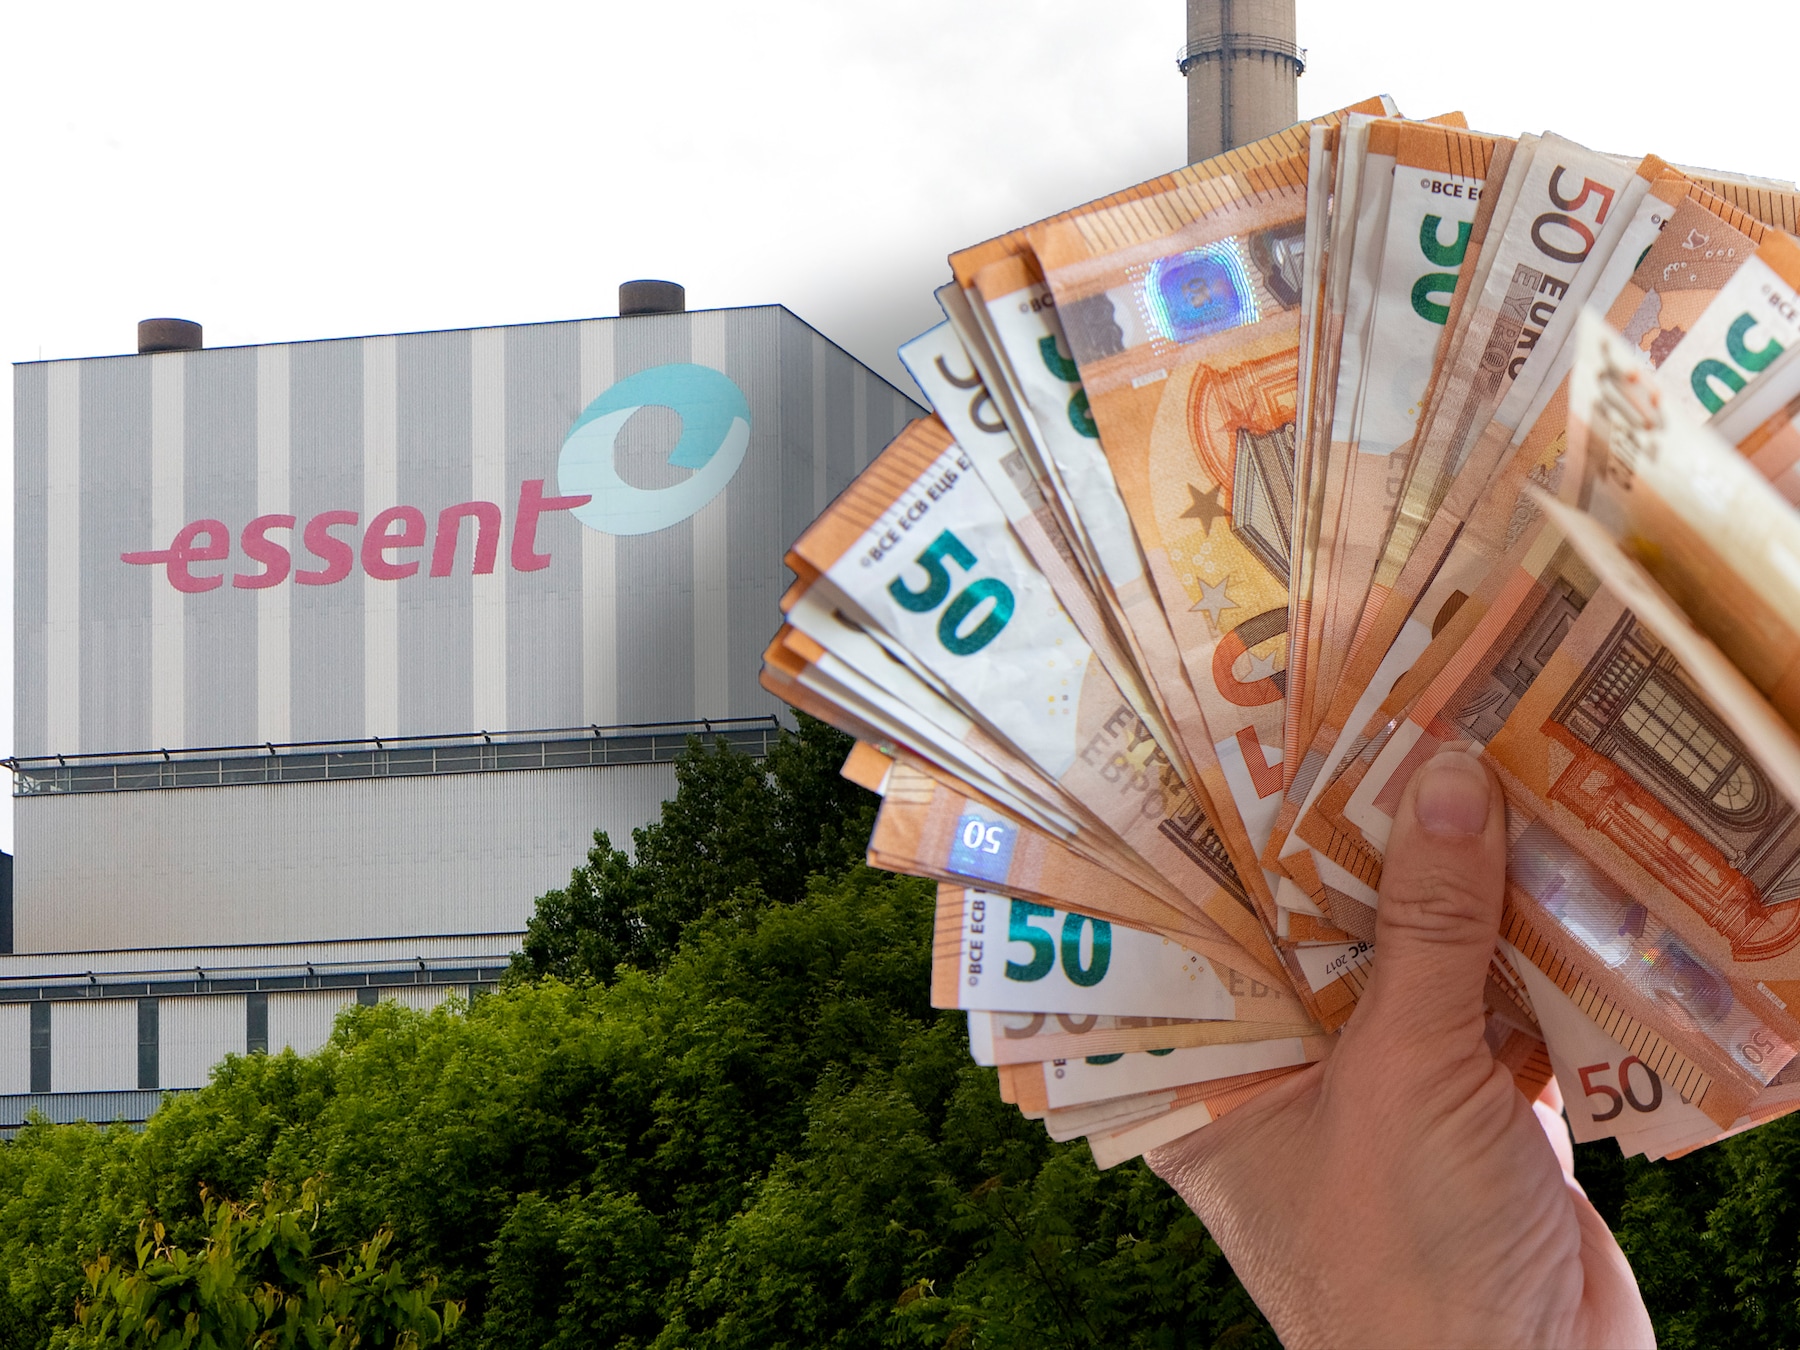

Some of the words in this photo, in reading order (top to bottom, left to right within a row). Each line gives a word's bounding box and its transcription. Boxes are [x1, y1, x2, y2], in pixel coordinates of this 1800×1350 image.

[1531, 164, 1616, 264] 50
[121, 479, 593, 594] essent
[897, 500, 929, 531] ECB
[886, 528, 1015, 656] 50
[963, 820, 1004, 855] 50
[971, 900, 986, 934] ECB
[1003, 898, 1112, 987] 50
[1325, 954, 1348, 975] 2017
[1742, 1031, 1776, 1065] 50
[1577, 1055, 1663, 1123] 50
